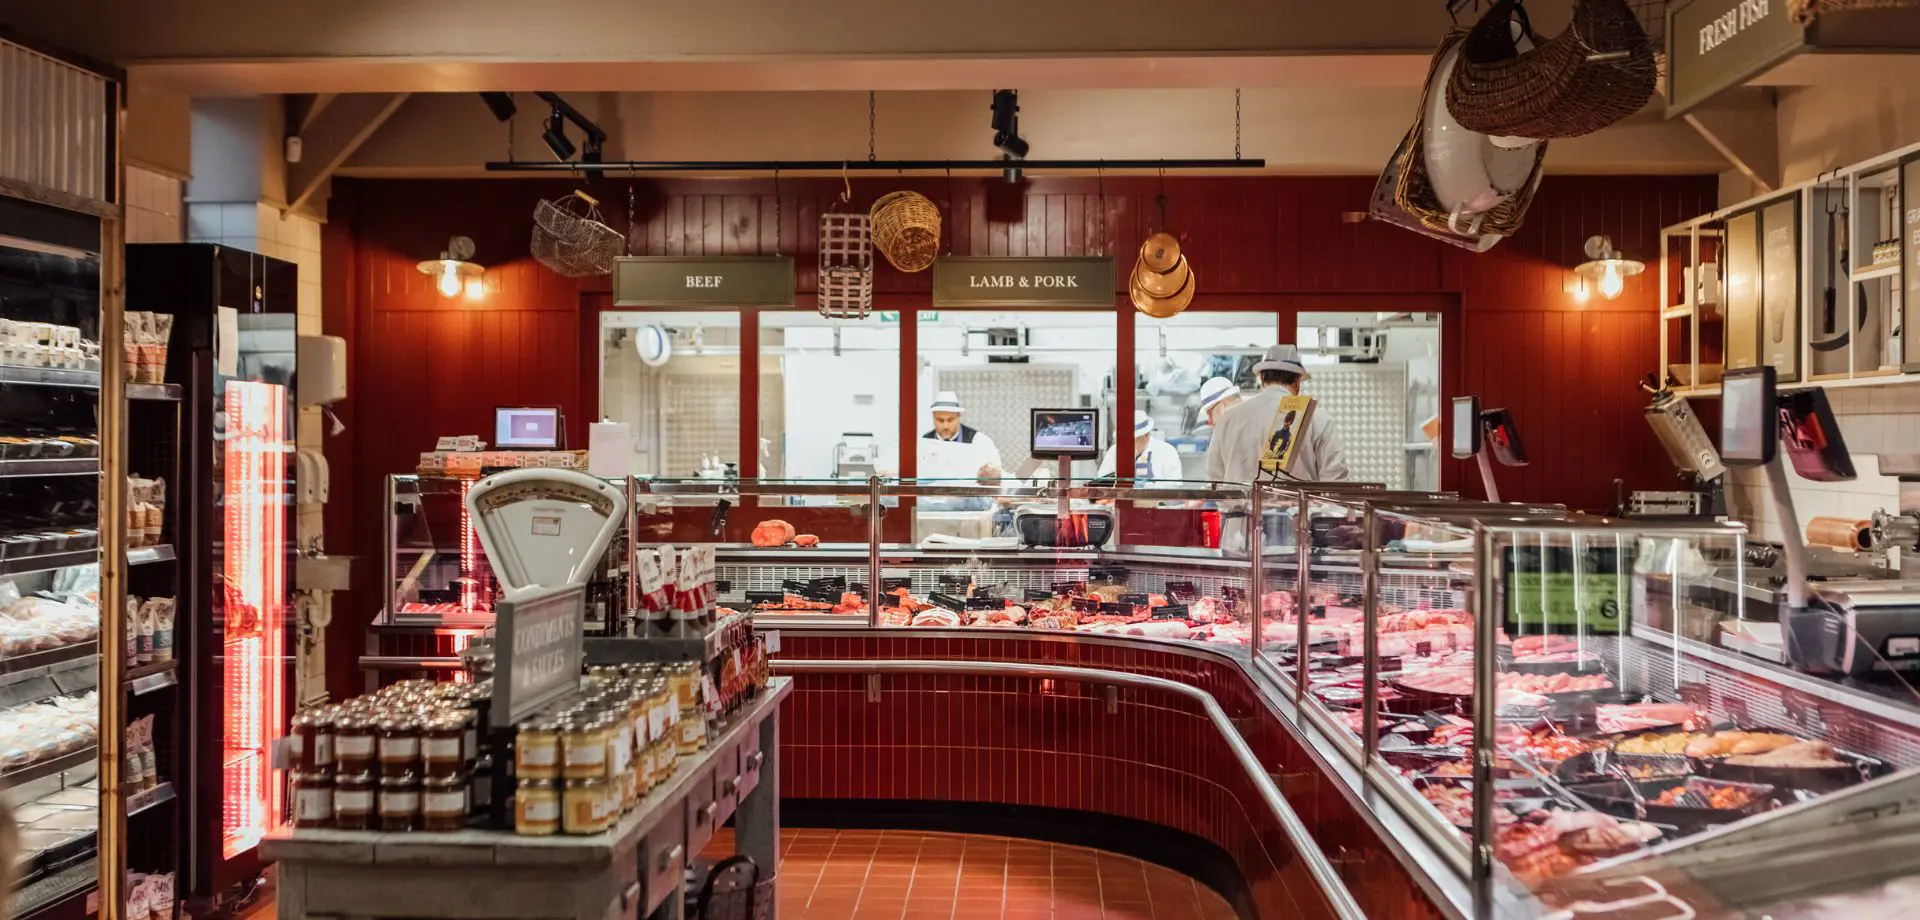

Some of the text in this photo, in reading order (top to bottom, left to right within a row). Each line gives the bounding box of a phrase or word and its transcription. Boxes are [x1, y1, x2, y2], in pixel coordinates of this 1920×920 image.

[1699, 0, 1769, 55] FRESH FISH
[686, 275, 723, 288] BEEF
[970, 275, 1078, 287] LAMB & PORK
[514, 613, 575, 656] CONDIMENTS
